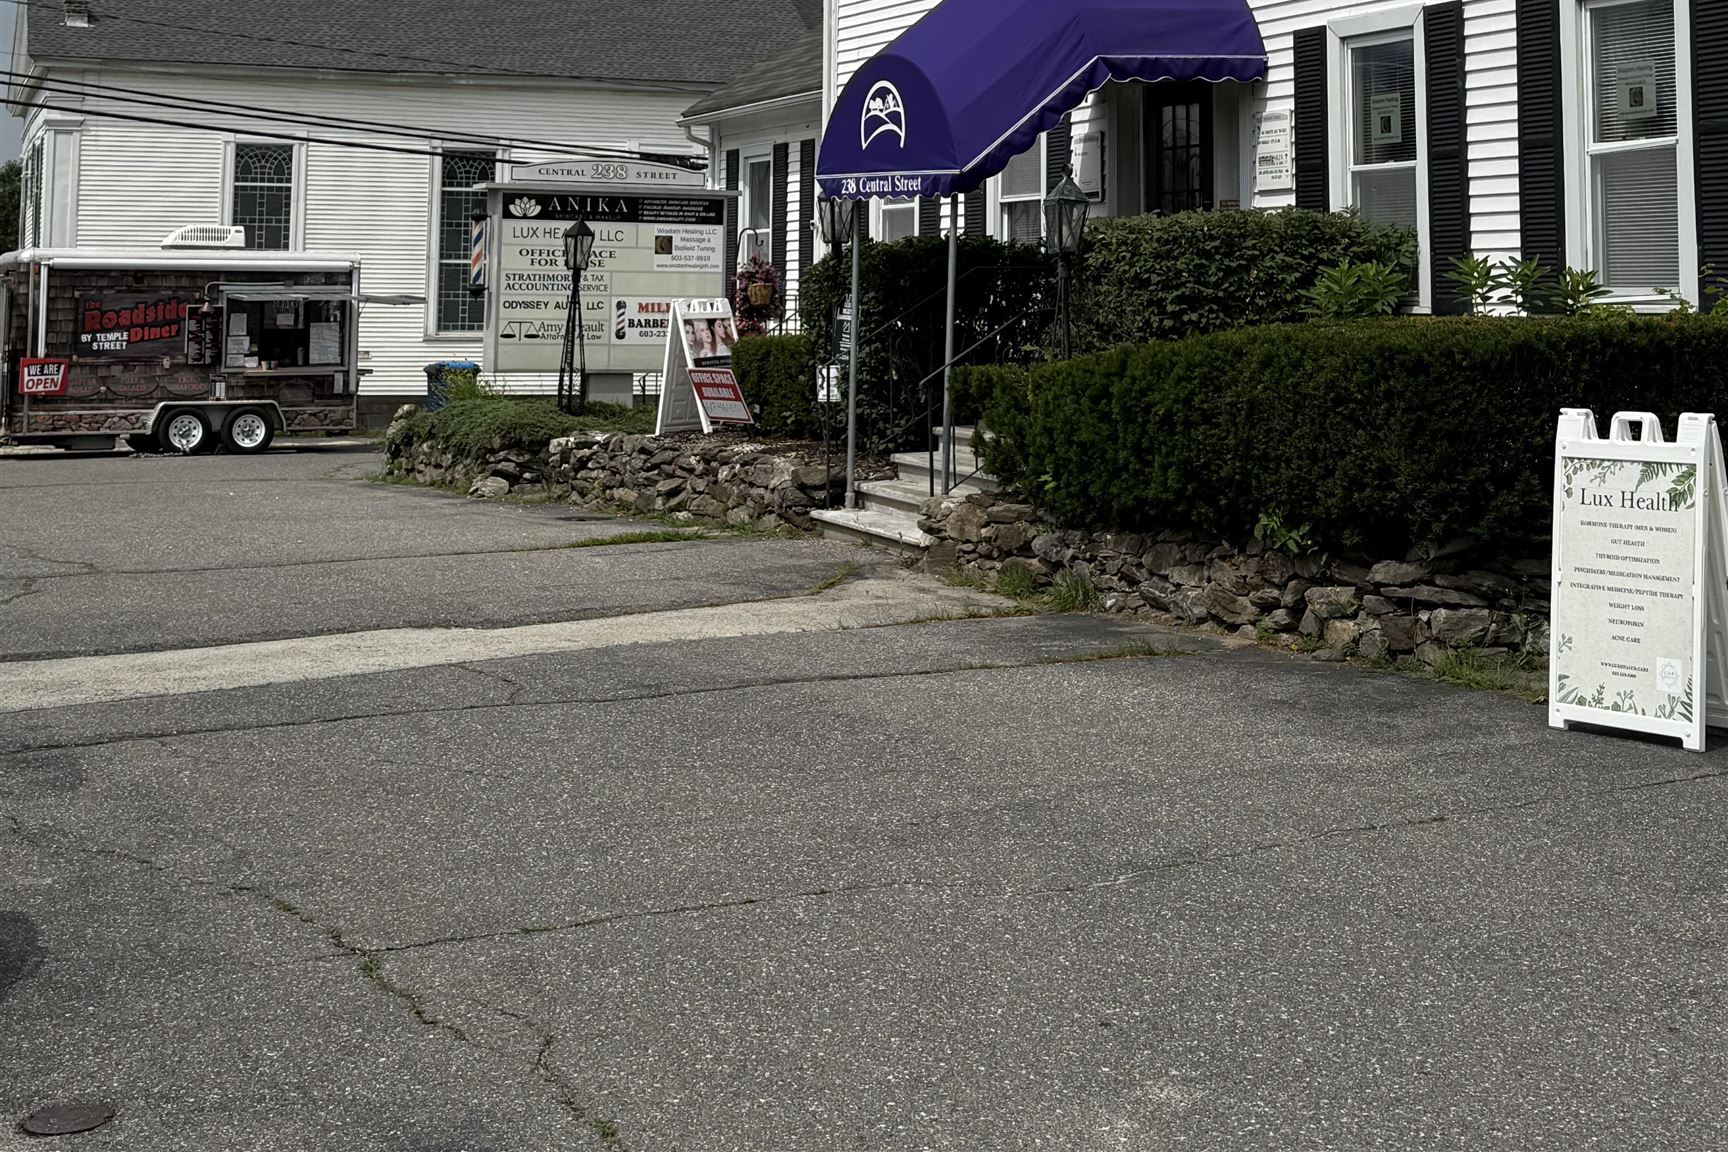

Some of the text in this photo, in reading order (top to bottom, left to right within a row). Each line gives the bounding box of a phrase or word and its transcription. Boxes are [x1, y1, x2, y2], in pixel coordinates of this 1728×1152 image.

[538, 163, 678, 180] CENTRAL 238 STREET
[841, 175, 922, 194] 238 Central Street
[548, 196, 628, 213] ANIKA
[513, 227, 539, 238] LUX
[600, 229, 624, 242] LLC
[680, 236, 706, 244] Massage
[589, 250, 616, 259] ACE
[530, 258, 559, 266] FOR
[504, 273, 605, 282] STRATHMOR & TAX
[579, 284, 609, 292] SERVICE
[503, 300, 604, 310] ODYSSEY AU LLC
[538, 321, 564, 335] Amy
[628, 318, 669, 328] BARBE
[81, 332, 129, 343] BY TEMPLE
[130, 324, 179, 342] Diner
[540, 332, 567, 340] Attorn
[587, 332, 602, 340] Law
[92, 341, 127, 351] STREET
[29, 363, 59, 376] WE ARE
[25, 376, 59, 391] OPEN
[1580, 488, 1680, 512] Lux Health
[1580, 520, 1608, 528] HORMONE
[1608, 521, 1634, 530] THERAPY
[1610, 538, 1646, 547] GUT HEALTH
[1595, 552, 1620, 561] THYROID
[1570, 581, 1606, 591] INTEGRATIVE
[1659, 591, 1684, 600] THERAPY
[1608, 602, 1645, 612] WEIGHT LOSS
[1610, 635, 1641, 644] ACNE CARE
